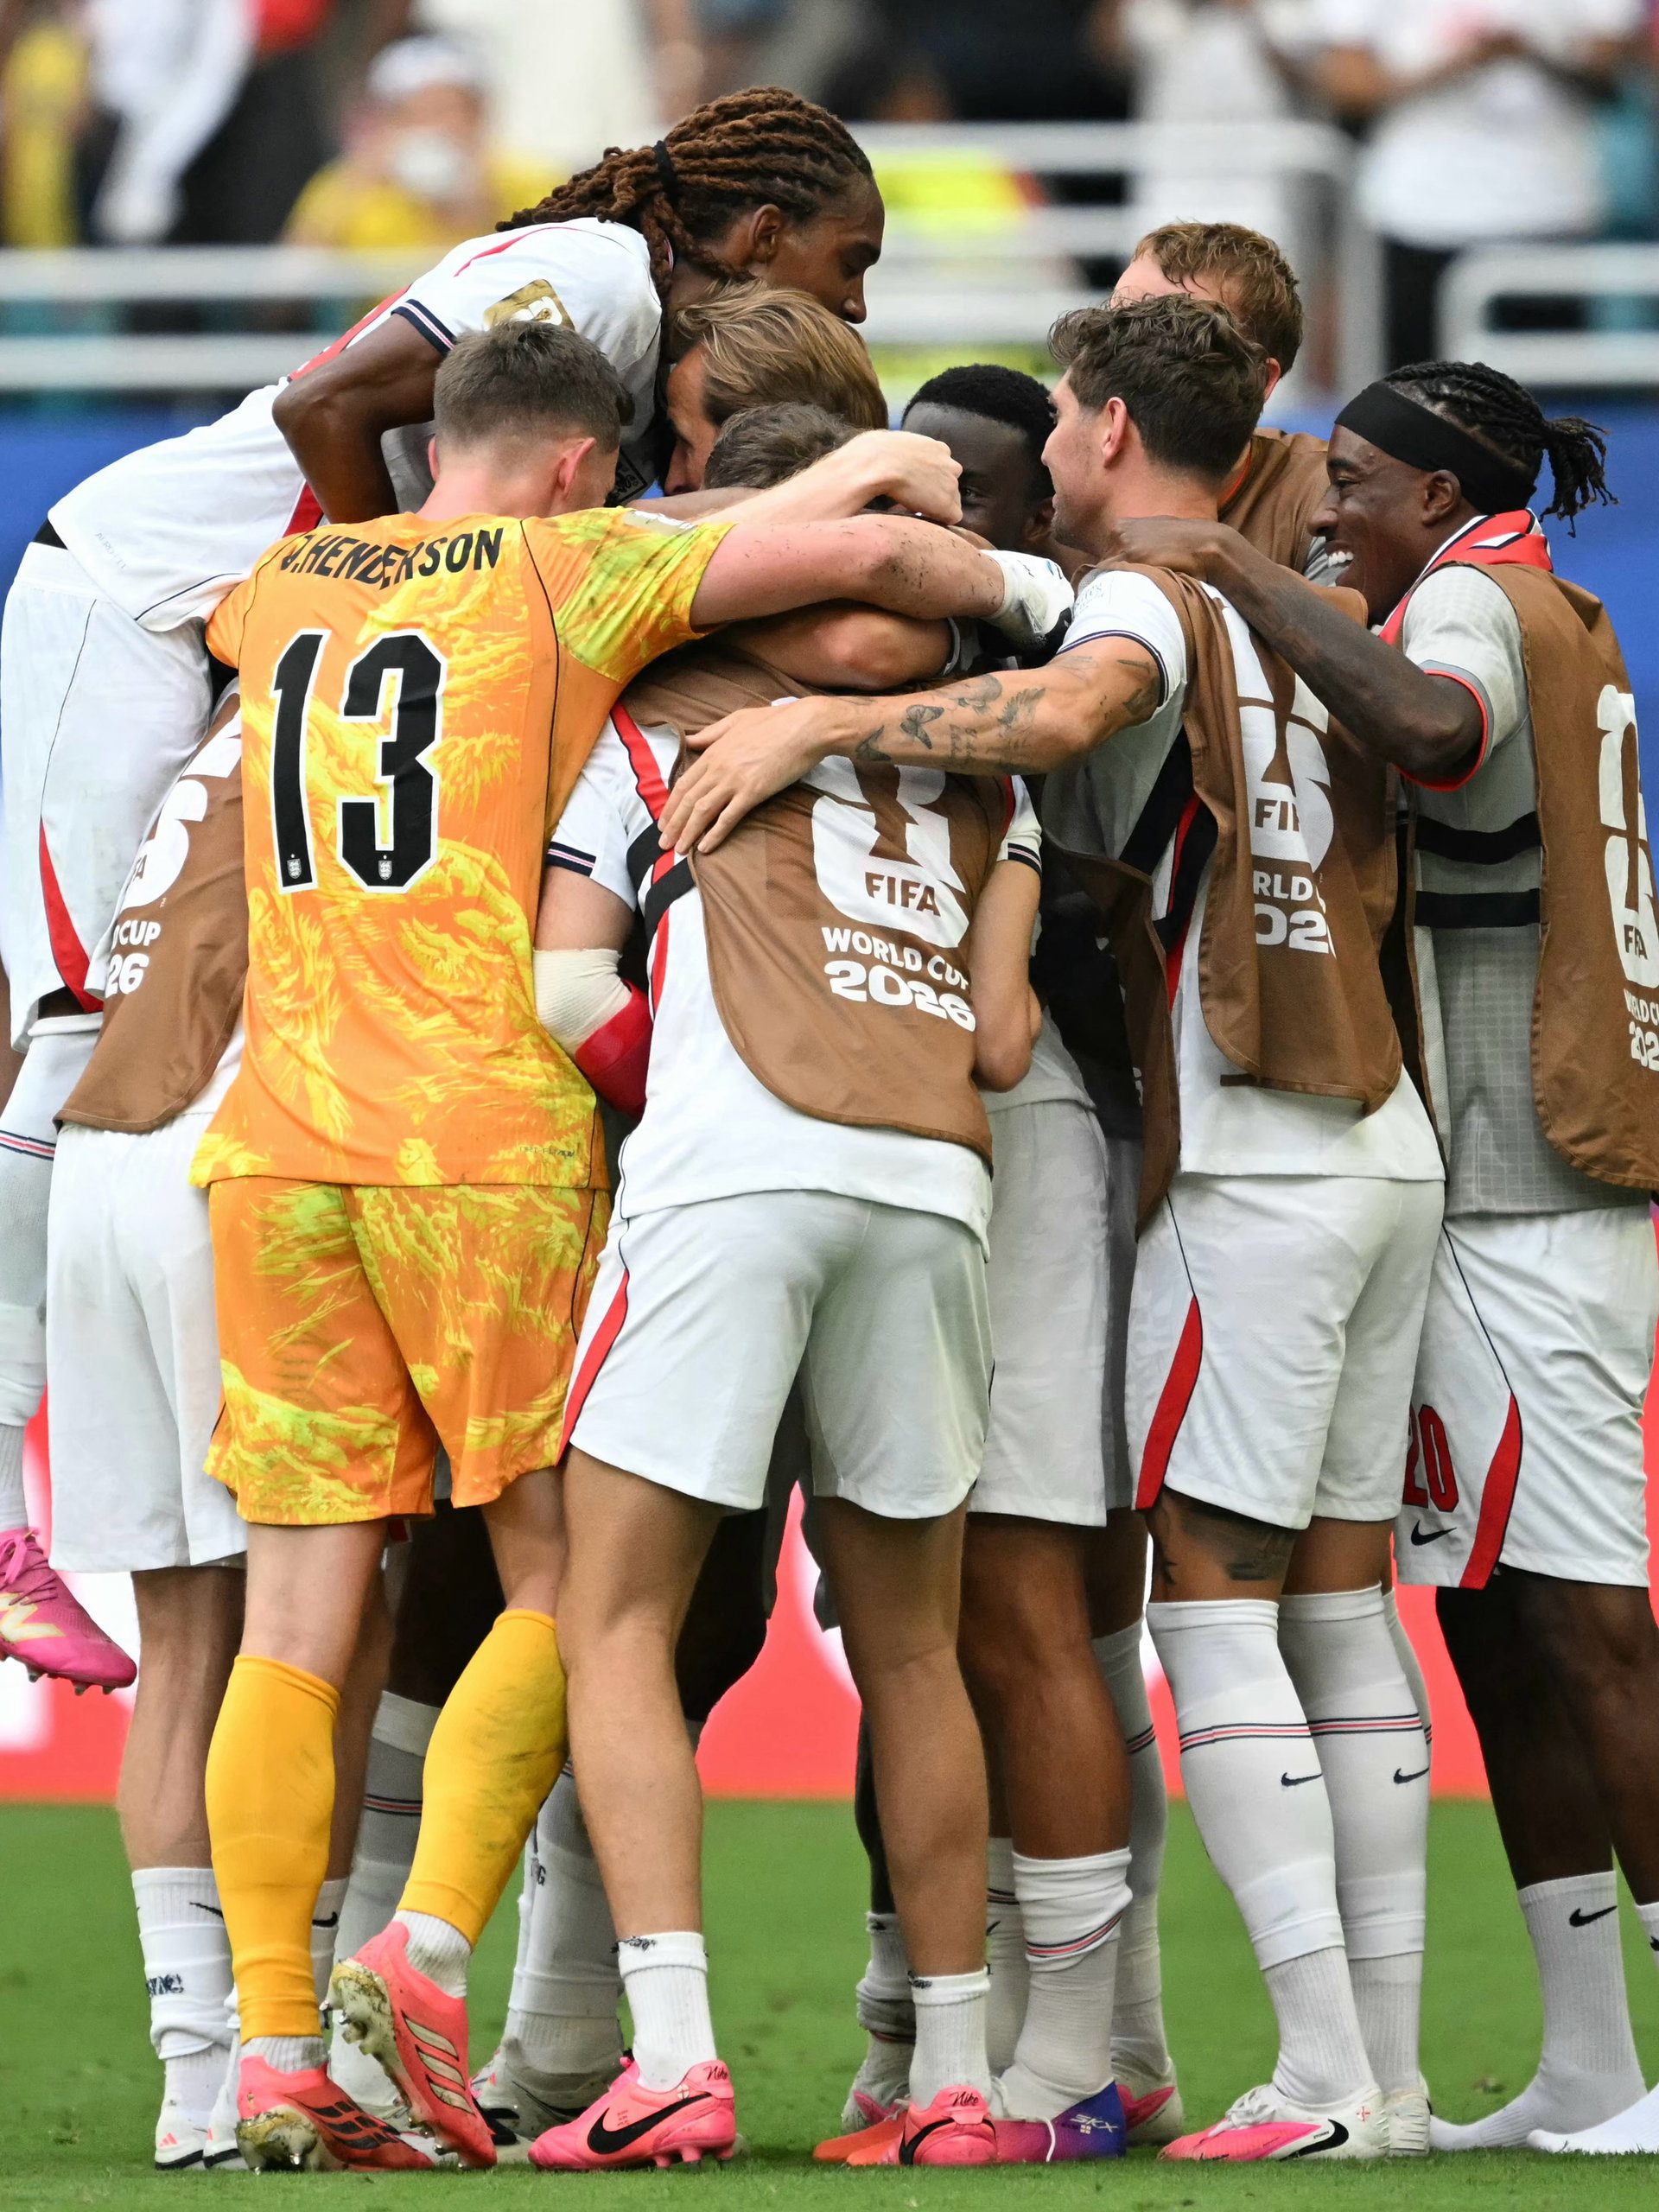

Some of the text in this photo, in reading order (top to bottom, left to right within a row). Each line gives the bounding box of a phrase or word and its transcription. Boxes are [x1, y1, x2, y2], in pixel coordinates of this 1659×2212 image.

[269, 628, 448, 894] 13
[865, 872, 941, 917] FIFA
[118, 919, 162, 946] CUP
[821, 926, 922, 972] WORLD
[105, 952, 149, 999] 26
[823, 960, 976, 1033] 2026
[950, 2091, 979, 2107] Nike
[1070, 2113, 1118, 2133] SKX
